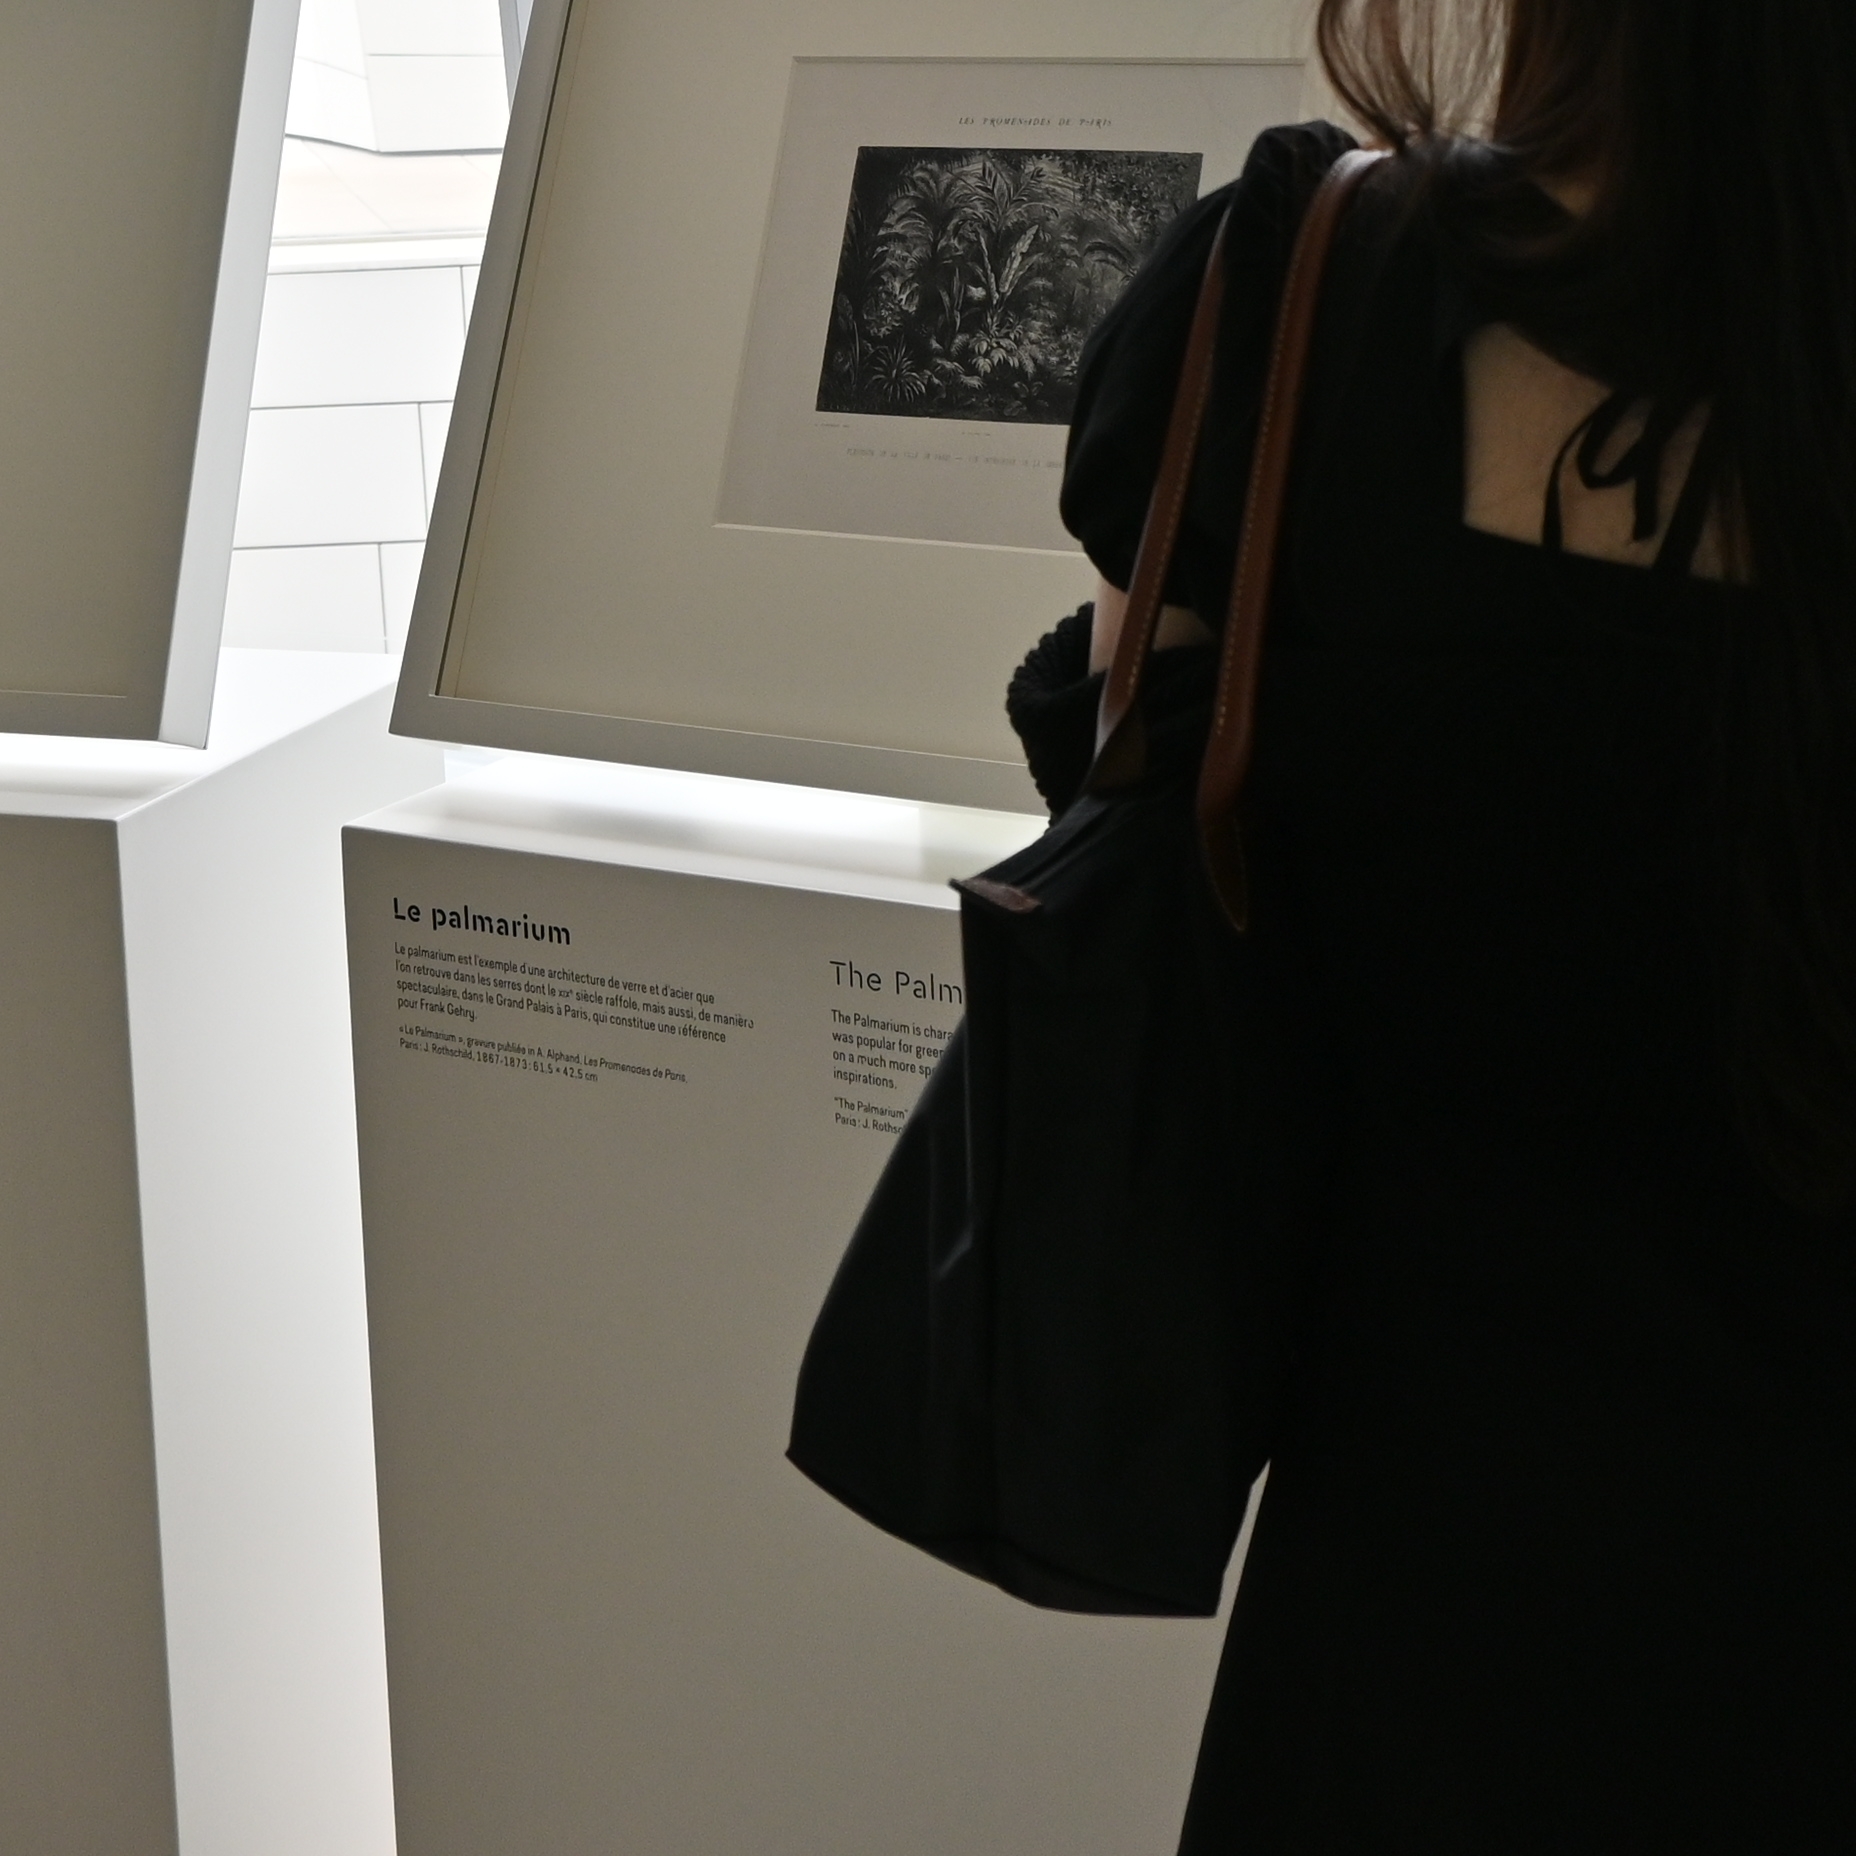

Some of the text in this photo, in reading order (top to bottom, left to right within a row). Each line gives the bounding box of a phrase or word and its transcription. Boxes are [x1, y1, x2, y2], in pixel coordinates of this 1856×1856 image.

[393, 897, 570, 945] Le palmarium
[394, 941, 715, 1005] Le palmarium est l'exemple d'une architecture de verre et d'acier que
[395, 959, 711, 1022] l'on retrouve dans les serres dont le siècle raffole, mais aussi, de
[829, 960, 962, 1004] The Palm
[397, 997, 478, 1022] pour Frank Gehry.
[462, 988, 484, 1003] dans
[486, 991, 494, 1004] le
[496, 993, 524, 1009] Grand
[526, 997, 554, 1014] Palais
[556, 1003, 562, 1015] à
[564, 1004, 591, 1022] Paris,
[592, 1012, 608, 1025] qui
[609, 1015, 656, 1031] constitue
[657, 1023, 676, 1034] une
[678, 1023, 726, 1043] référence
[831, 1008, 955, 1040] The Palmarium is chara
[832, 1032, 854, 1044] was
[856, 1035, 896, 1050] popular
[898, 1038, 913, 1053] for
[832, 1050, 916, 1073] on a much more
[833, 1066, 897, 1089] inspirations.
